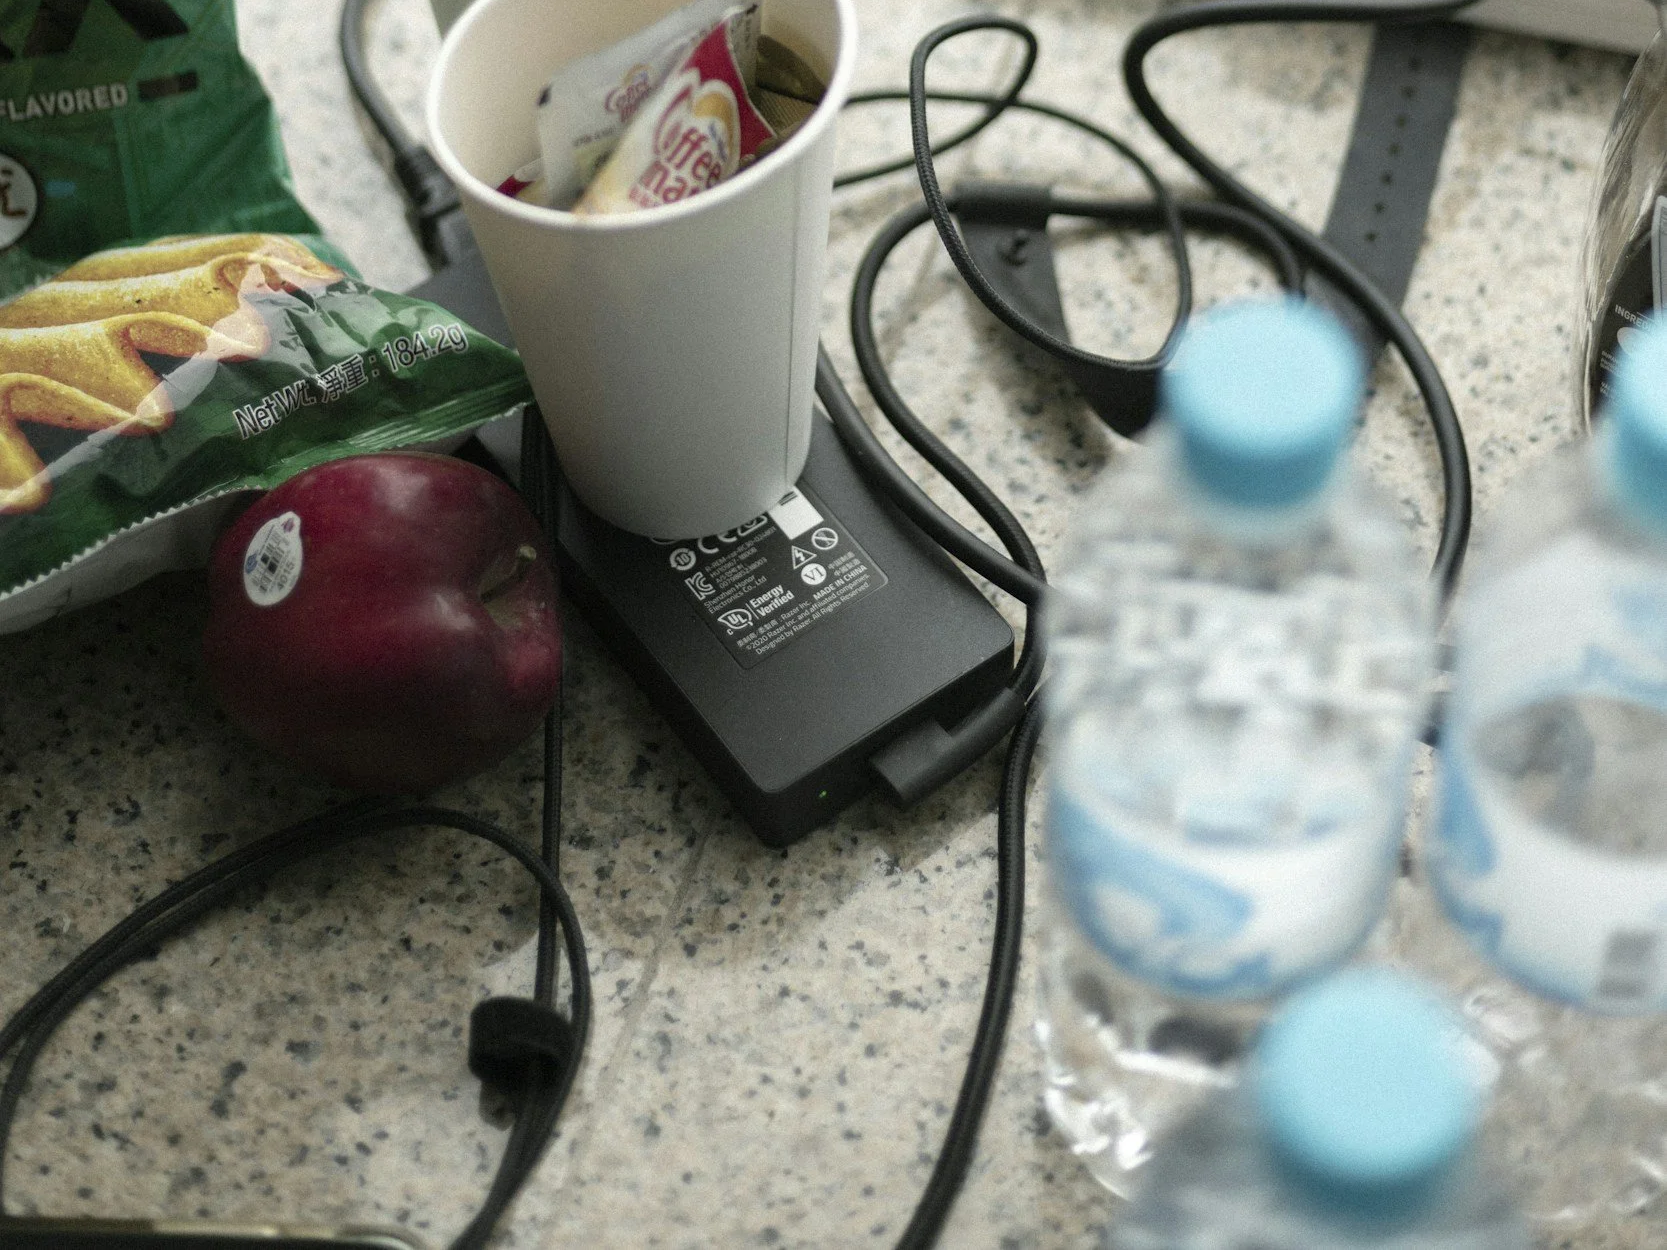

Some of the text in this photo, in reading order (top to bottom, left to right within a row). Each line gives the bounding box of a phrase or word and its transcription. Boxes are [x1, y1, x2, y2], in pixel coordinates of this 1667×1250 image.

[639, 160, 701, 205] ma
[233, 391, 280, 440] Net
[276, 380, 316, 417] Wt.
[382, 322, 469, 374] 184.2g
[804, 567, 824, 581] VI
[813, 584, 835, 599] MADE
[843, 564, 866, 580] CHINA
[704, 575, 755, 607] Shenzhen Honor
[709, 590, 743, 612] Electronics
[755, 576, 766, 584] Ltd
[750, 584, 783, 607] Energy
[757, 590, 794, 616] Verified
[727, 613, 747, 625] UL
[767, 624, 786, 637] Razer
[786, 617, 797, 626] Inc.
[797, 610, 809, 619] and
[808, 593, 836, 612] affiliated
[781, 606, 799, 619] Razer
[799, 599, 810, 608] Inc.
[756, 635, 784, 653] Designed
[784, 629, 793, 637] by
[792, 618, 812, 631] Razer.
[820, 600, 841, 614] Rights
